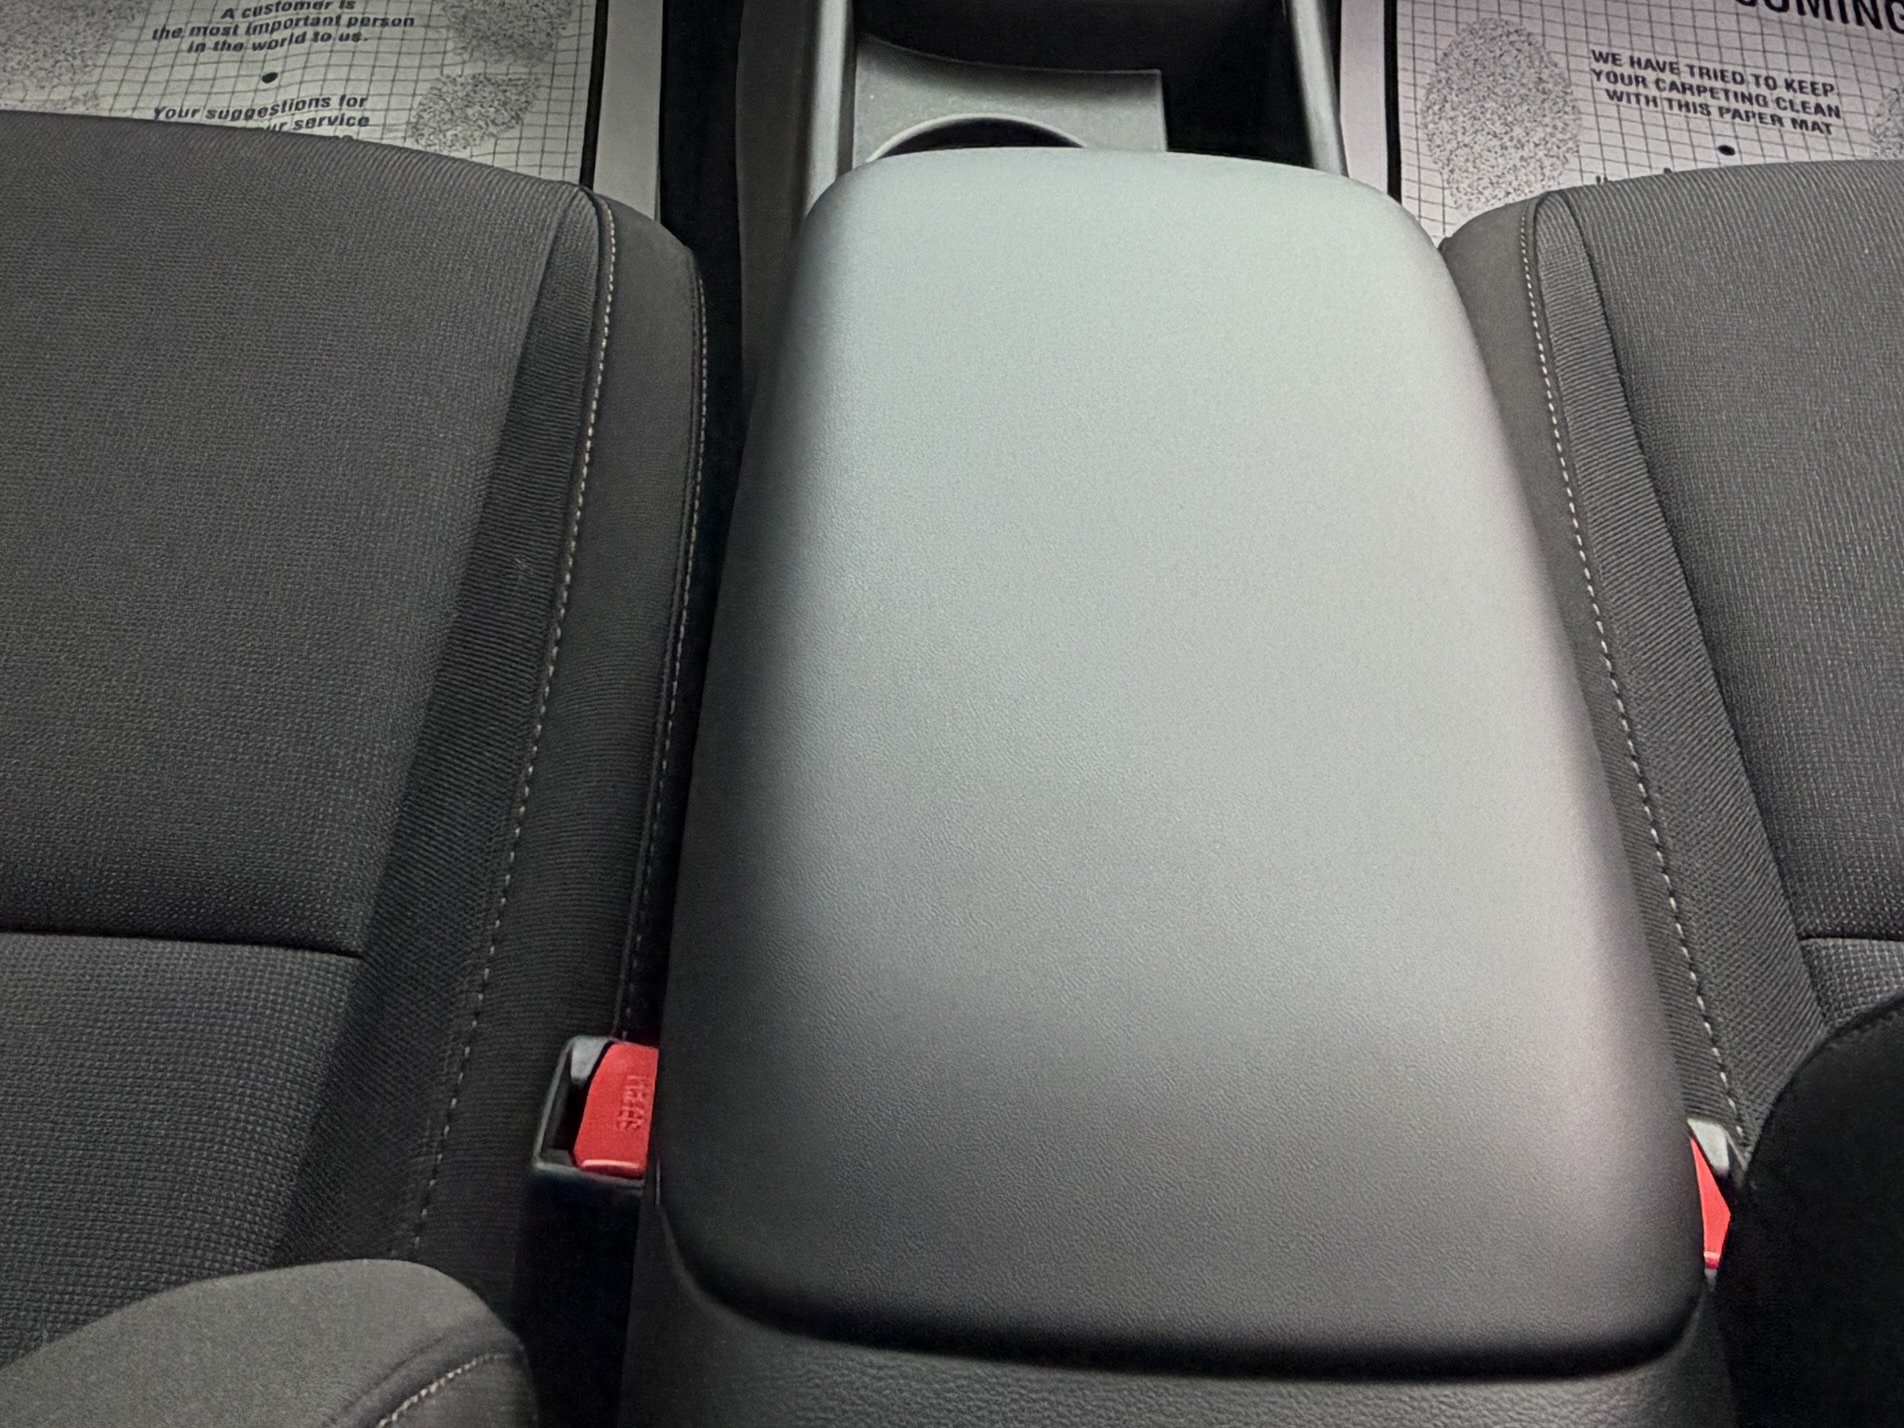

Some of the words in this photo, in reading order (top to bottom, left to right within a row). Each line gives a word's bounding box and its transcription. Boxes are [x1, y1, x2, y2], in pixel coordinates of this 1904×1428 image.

[220, 7, 236, 21] A
[240, 0, 333, 20] customer
[151, 24, 184, 41] the
[188, 24, 240, 39] most
[244, 13, 342, 37] important
[345, 15, 415, 30] person
[186, 40, 208, 54] in
[212, 38, 246, 54] the
[251, 31, 308, 53] world
[312, 29, 334, 44] to
[337, 31, 370, 44] us.
[1590, 48, 1625, 68] WE
[1628, 53, 1681, 76] HAVE
[1684, 62, 1746, 86] TRIED
[1751, 73, 1779, 93] TO
[1783, 78, 1836, 98] KEEP
[153, 105, 200, 122] Your
[204, 94, 331, 123] suggestions
[336, 93, 369, 109] for
[1590, 67, 1650, 90] YOUR
[1654, 78, 1771, 109] CARPETING
[1774, 95, 1844, 120] CLEAN
[291, 113, 370, 133] service
[1604, 87, 1660, 110] WITH
[1664, 96, 1713, 118] THIS
[1717, 106, 1784, 129] PAPER
[1790, 116, 1835, 136] MAT
